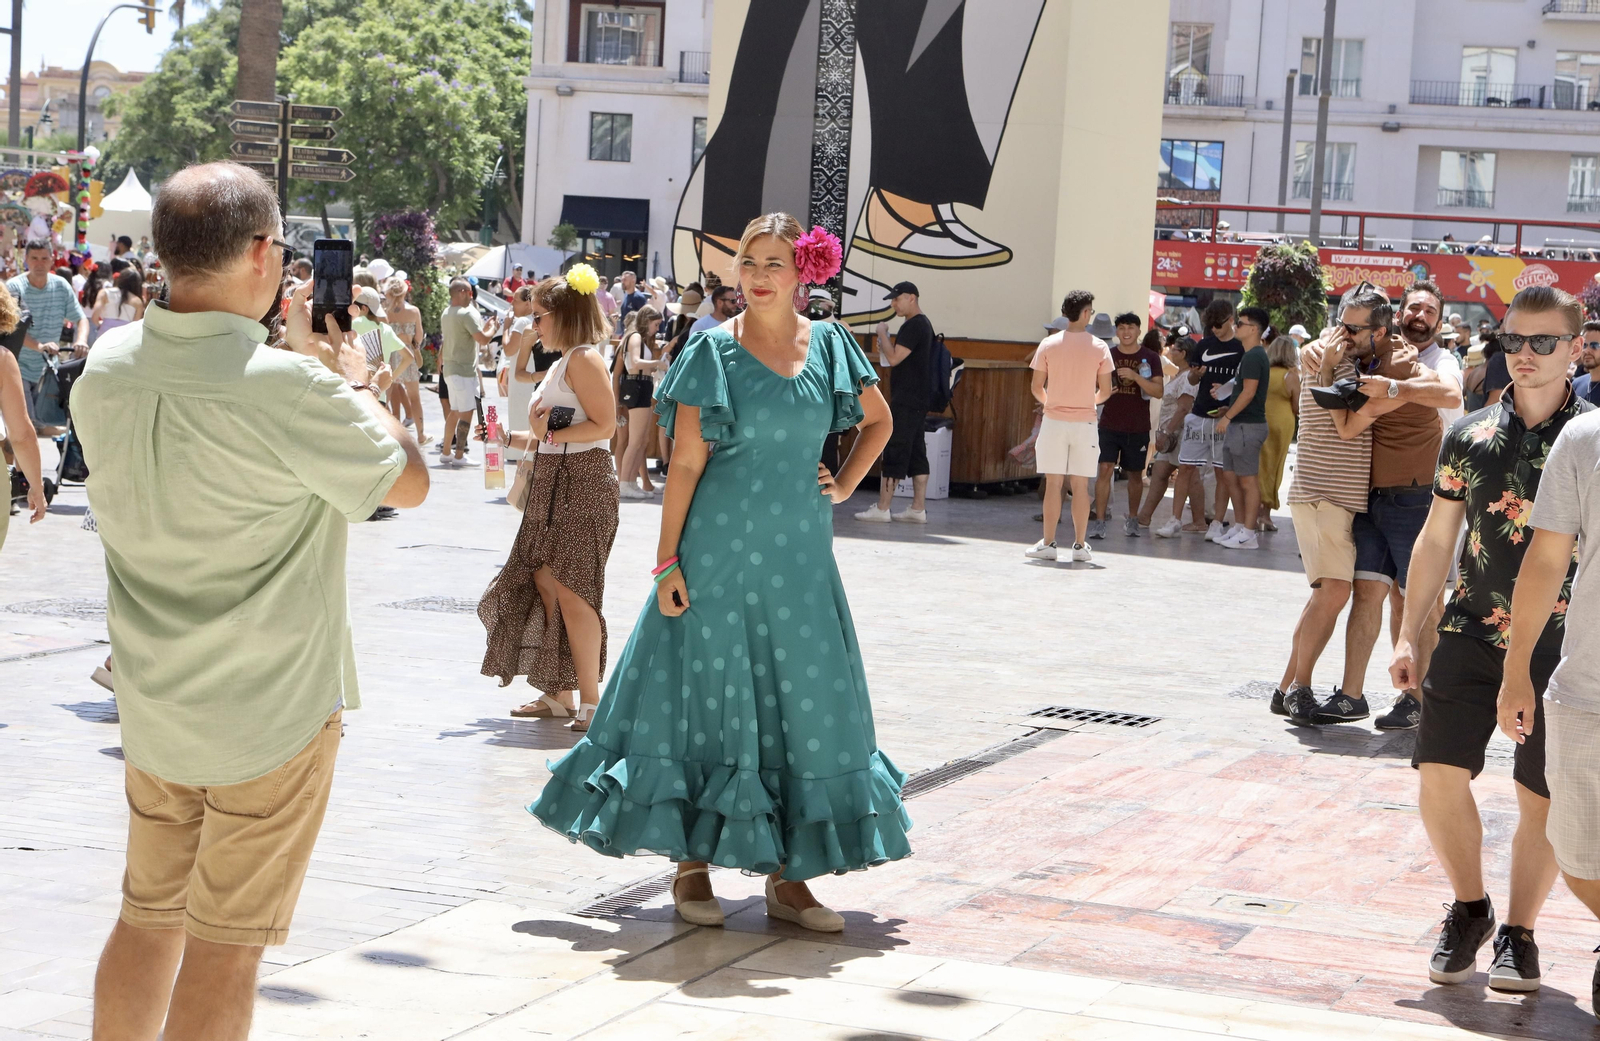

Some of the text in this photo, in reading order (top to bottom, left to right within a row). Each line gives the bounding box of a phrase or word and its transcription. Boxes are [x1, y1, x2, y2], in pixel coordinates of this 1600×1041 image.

[1156, 257, 1171, 270] 24
[1334, 255, 1401, 265] Worldwide
[1516, 273, 1557, 288] OFFICIAL
